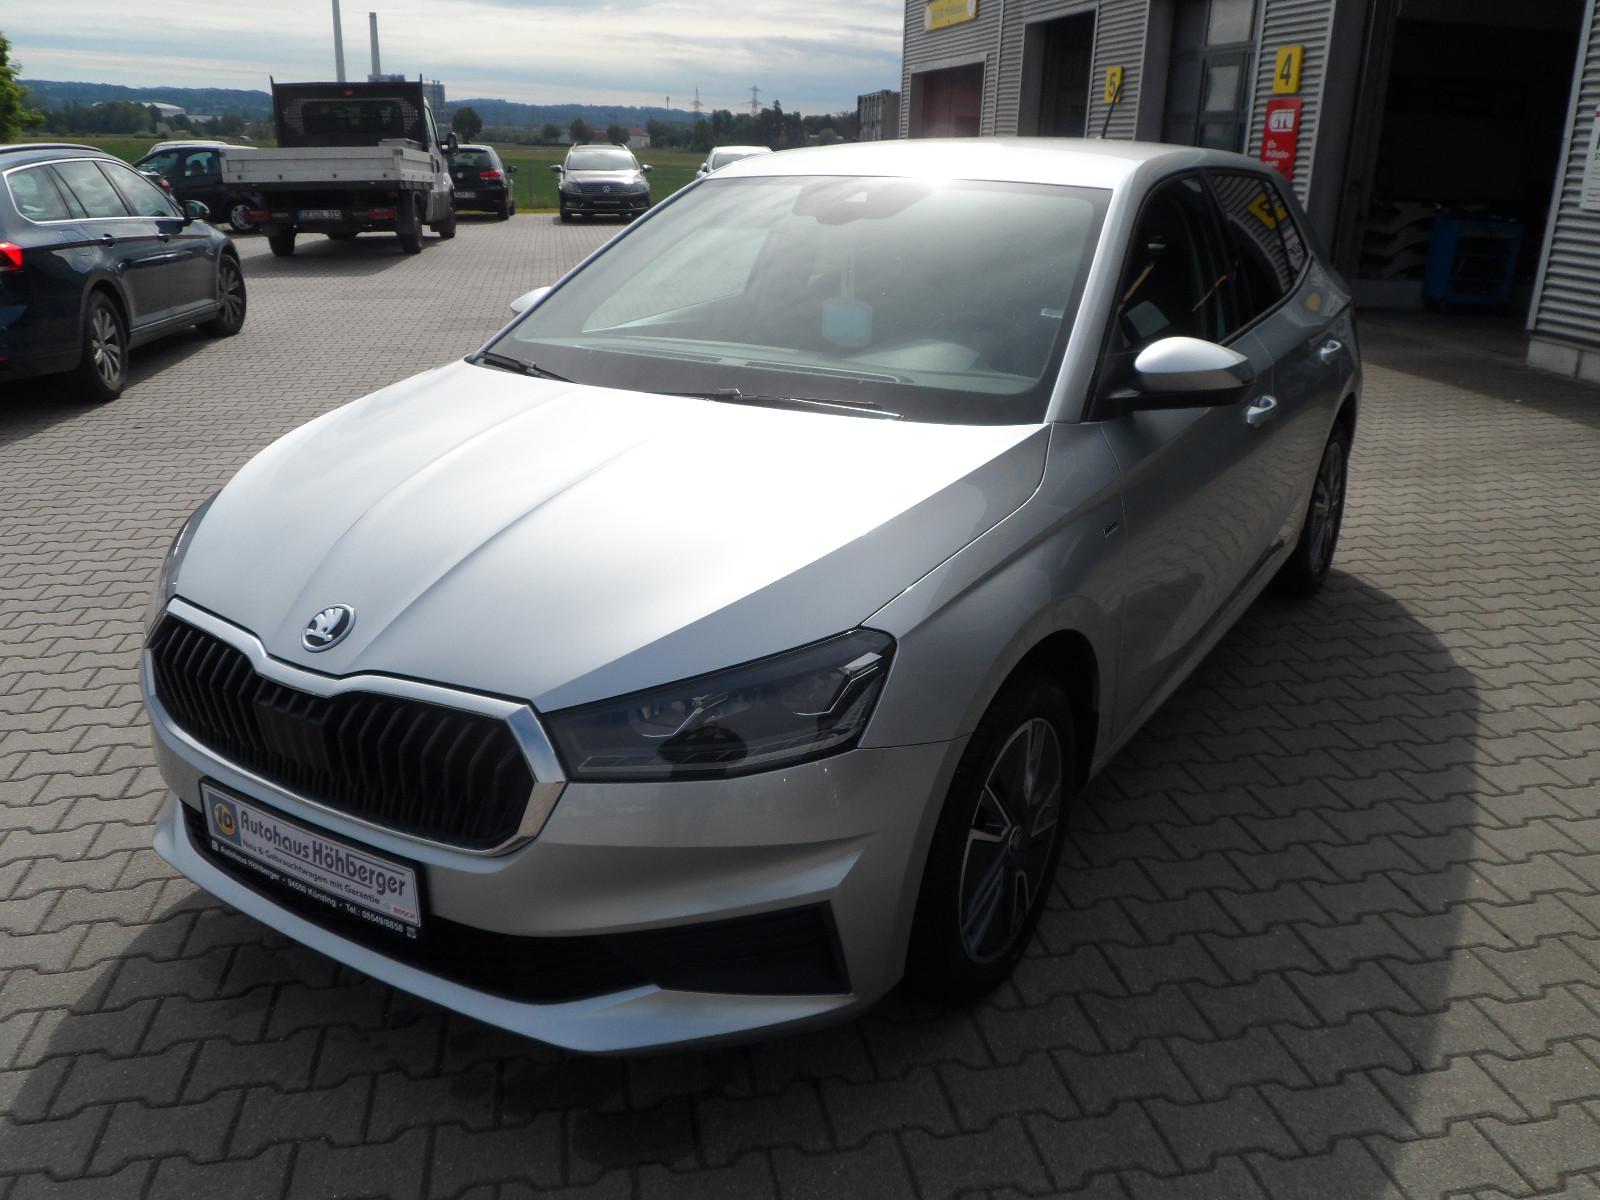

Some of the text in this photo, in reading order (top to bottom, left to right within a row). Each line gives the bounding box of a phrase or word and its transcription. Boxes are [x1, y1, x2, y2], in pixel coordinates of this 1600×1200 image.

[1109, 72, 1117, 96] 5
[1280, 58, 1292, 86] 4
[265, 849, 328, 883] Gebrauchtwagen
[329, 878, 343, 891] mit
[344, 884, 380, 905] Garantie
